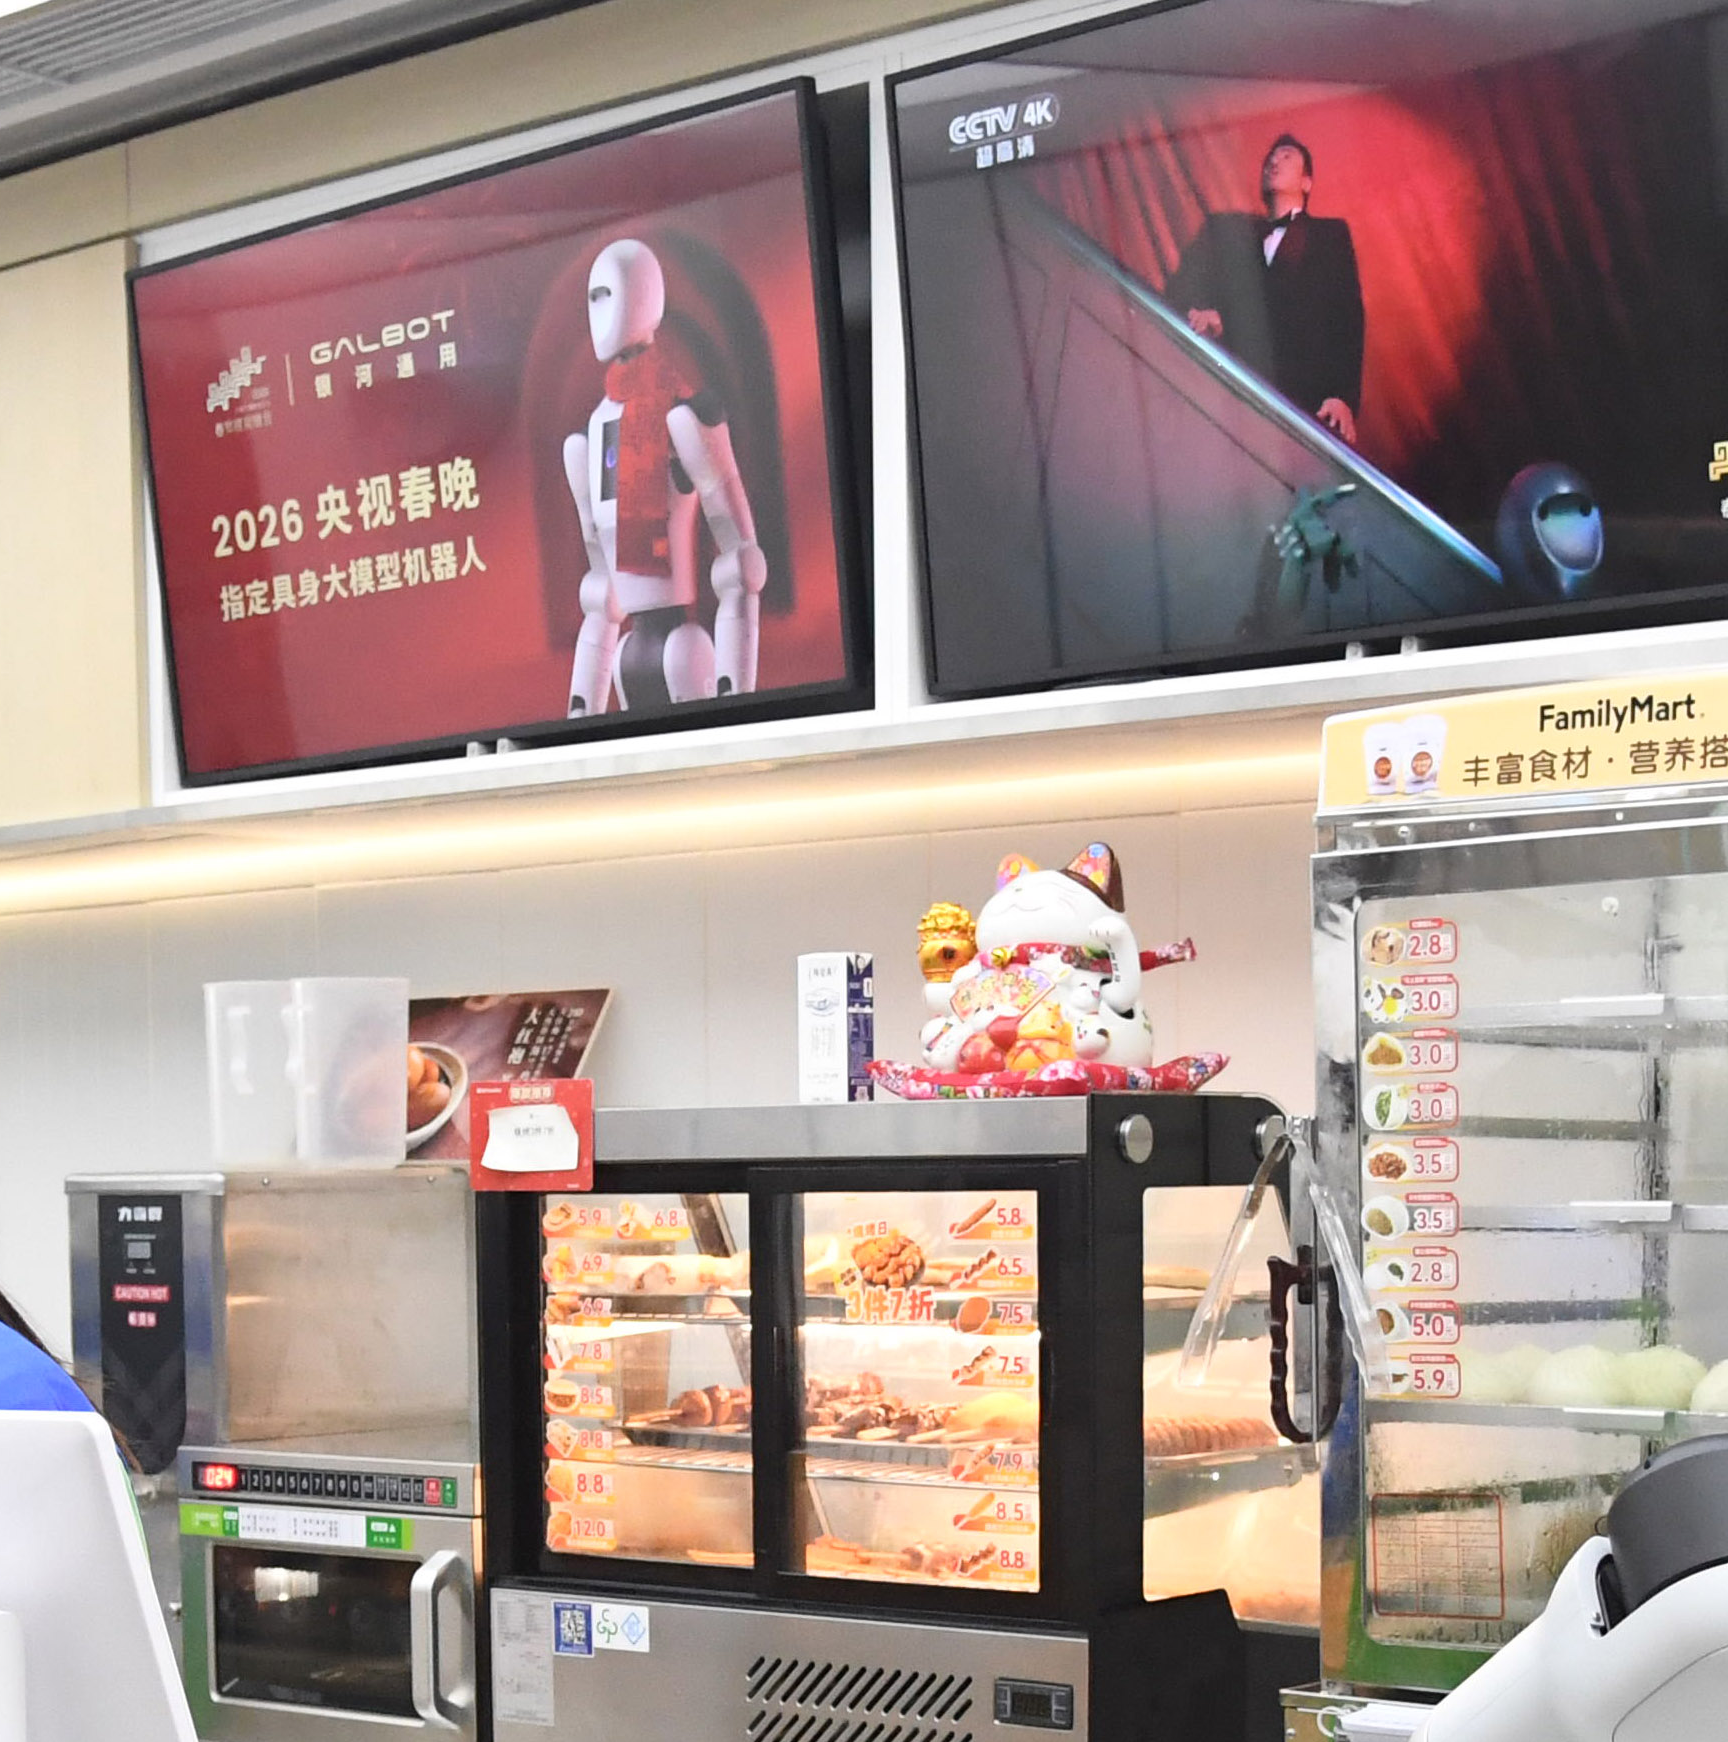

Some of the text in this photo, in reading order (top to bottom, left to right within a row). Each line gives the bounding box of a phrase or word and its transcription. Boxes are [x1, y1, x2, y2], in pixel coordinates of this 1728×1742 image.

[949, 98, 1053, 144] CCTV 4K
[310, 310, 455, 365] GALBOT
[315, 342, 457, 399] 银河通用
[211, 456, 480, 558] 2026 央视春晚
[220, 535, 487, 623] 指定具身大模型机器人
[1539, 693, 1695, 733] FamilyMart
[1409, 935, 1441, 957] 2.8
[1411, 990, 1441, 1011] 3.0
[1410, 1044, 1442, 1066] 3.0
[1411, 1098, 1442, 1120] 3.0
[1413, 1153, 1443, 1175] 3.5
[997, 1207, 1021, 1226] 5.8
[1416, 1209, 1444, 1230] 3.5
[997, 1257, 1022, 1276] 6.5
[1411, 1262, 1443, 1283] 2.8
[847, 1288, 934, 1321] 3件7折
[998, 1305, 1024, 1324] 7.5
[1412, 1316, 1445, 1337] 5.0
[998, 1355, 1024, 1374] 7.5
[1413, 1370, 1445, 1391] 5.9
[577, 1473, 604, 1493] 8.8
[996, 1501, 1024, 1521] 8.5
[1000, 1550, 1025, 1569] 8.8
